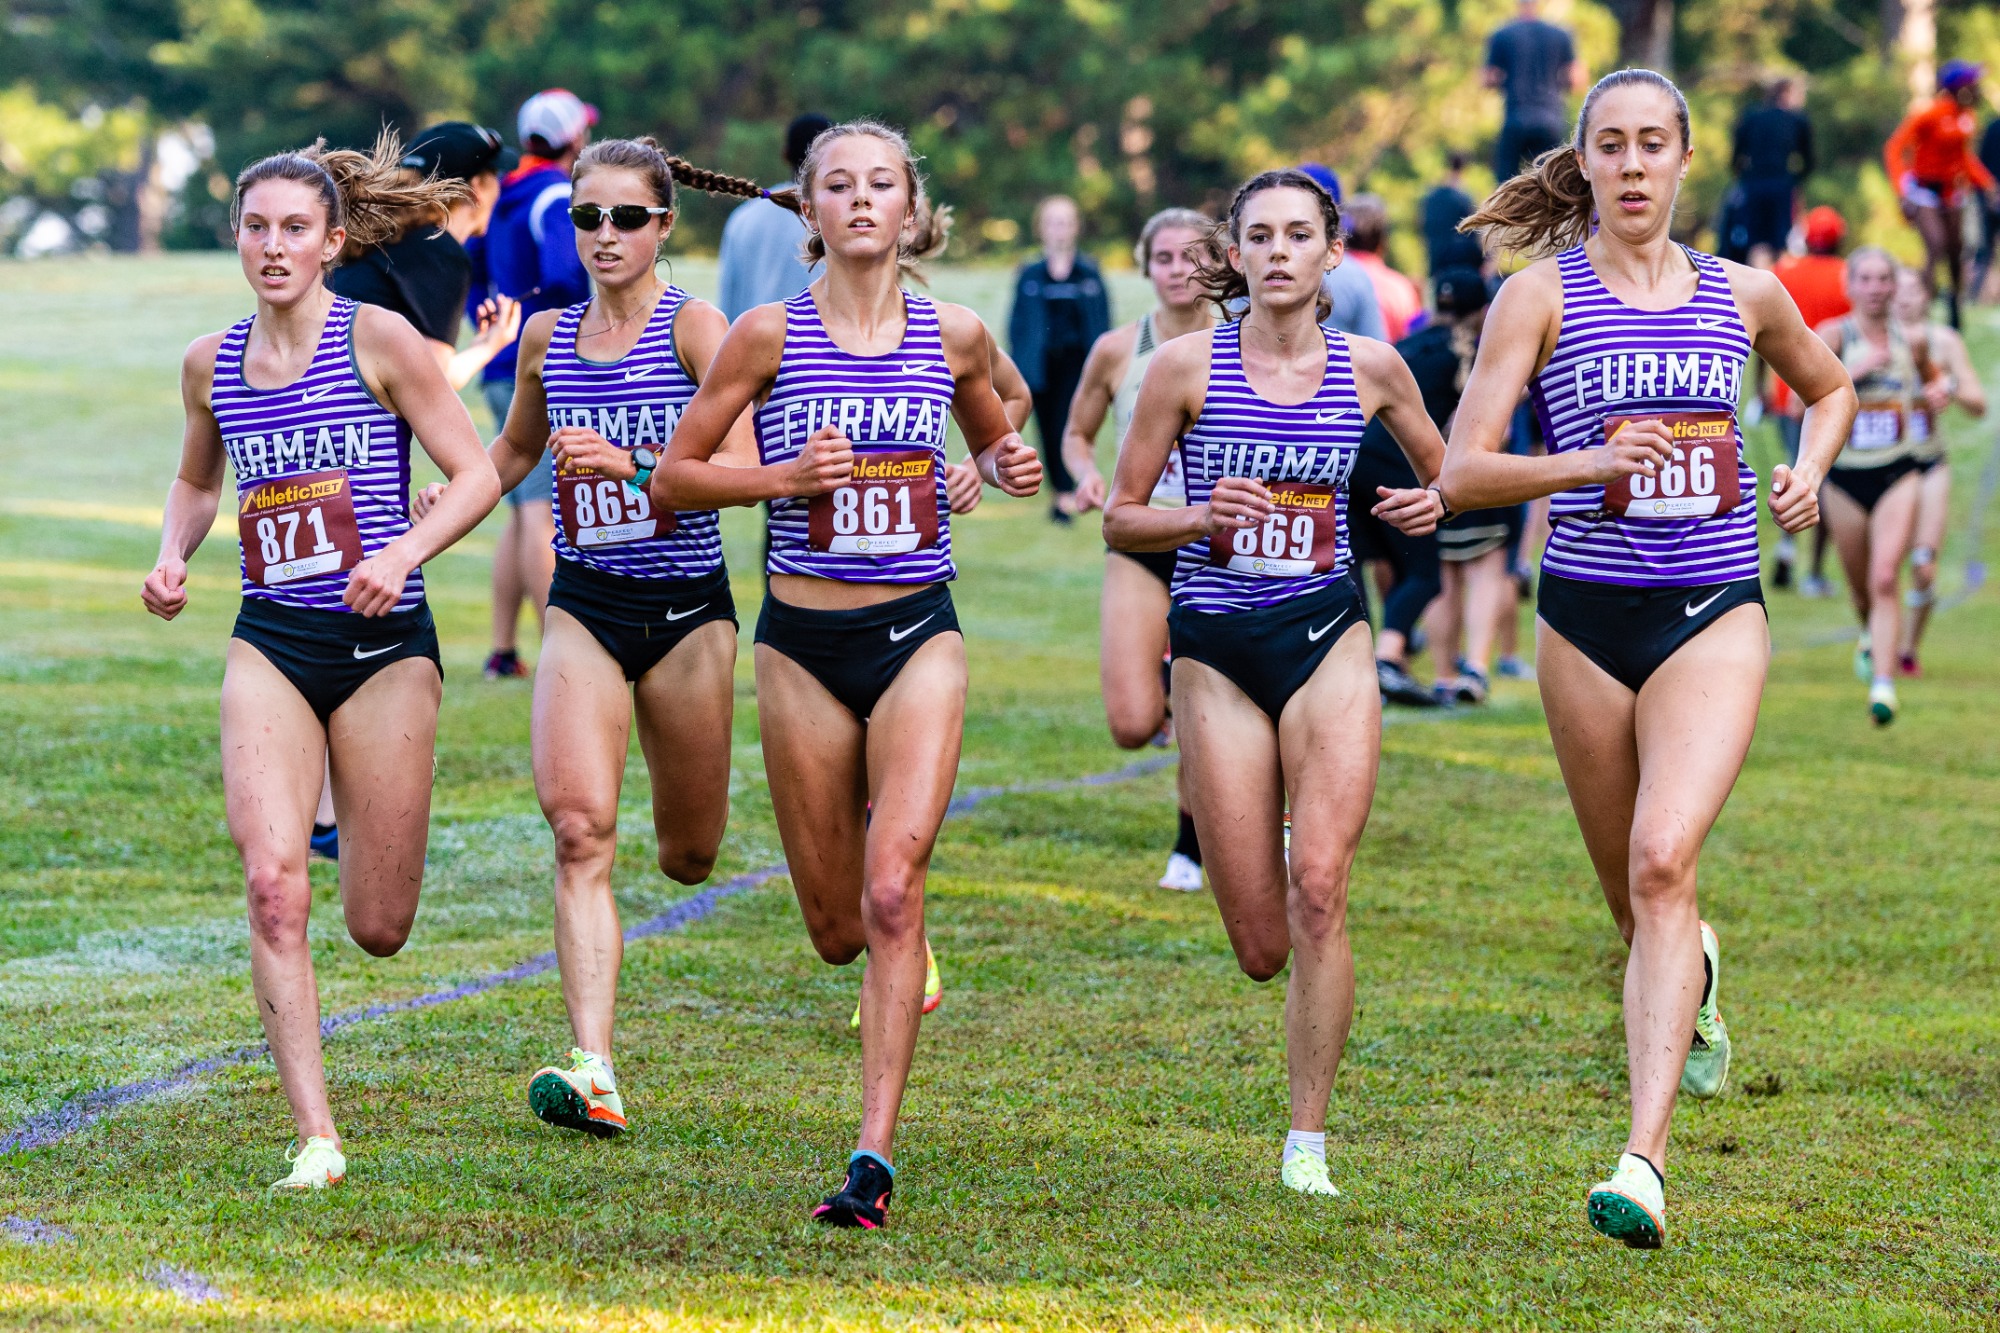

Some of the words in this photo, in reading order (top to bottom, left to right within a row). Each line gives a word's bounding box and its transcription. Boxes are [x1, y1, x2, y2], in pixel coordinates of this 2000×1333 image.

[1574, 352, 1745, 410] FURMAN
[783, 396, 949, 450] FURMAN
[224, 422, 371, 481] URMAN
[240, 485, 311, 514] Athletic
[574, 479, 650, 527] 865
[832, 486, 916, 535] 861
[256, 506, 335, 564] 871
[1232, 513, 1315, 560] 869
